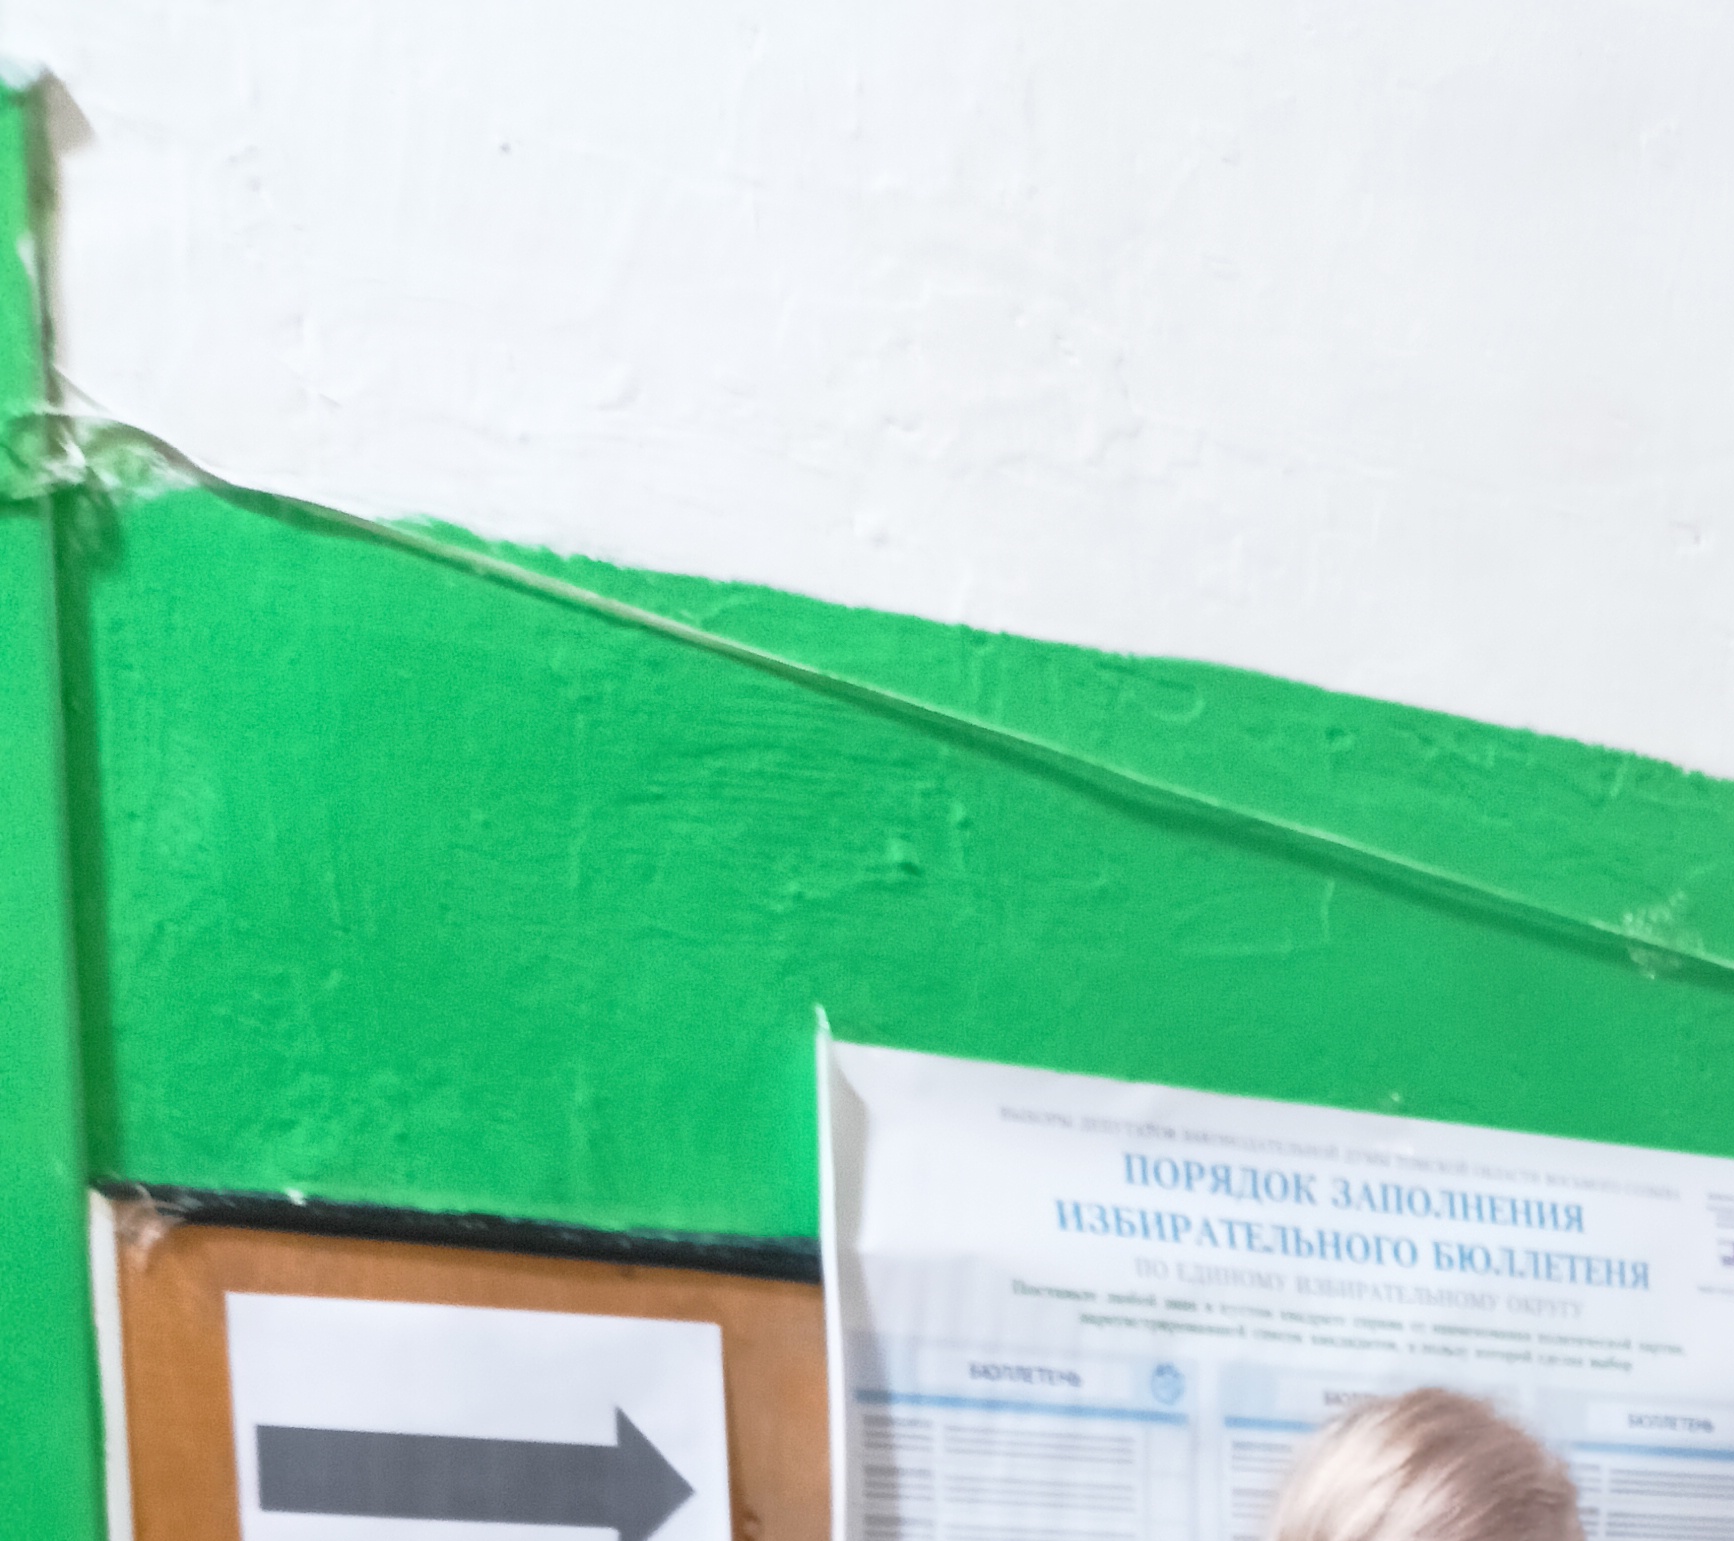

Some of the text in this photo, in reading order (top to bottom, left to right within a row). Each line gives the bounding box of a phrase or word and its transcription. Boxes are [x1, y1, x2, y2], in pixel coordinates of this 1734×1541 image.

[1123, 1152, 1585, 1234] ПОРЯДОК ЗАПОЛНЕНИЯ
[1056, 1199, 1651, 1290] ИЗБИРАТЕЛЬНОГО БЮЛЛЕТЕНЯ
[1134, 1257, 1584, 1320] ПО ЕДИНОМУ ИЗБИРАТЕЛЬНОМУ ОКРУГУ
[969, 1362, 1083, 1388] БЮЛЛЕТЕНЬ
